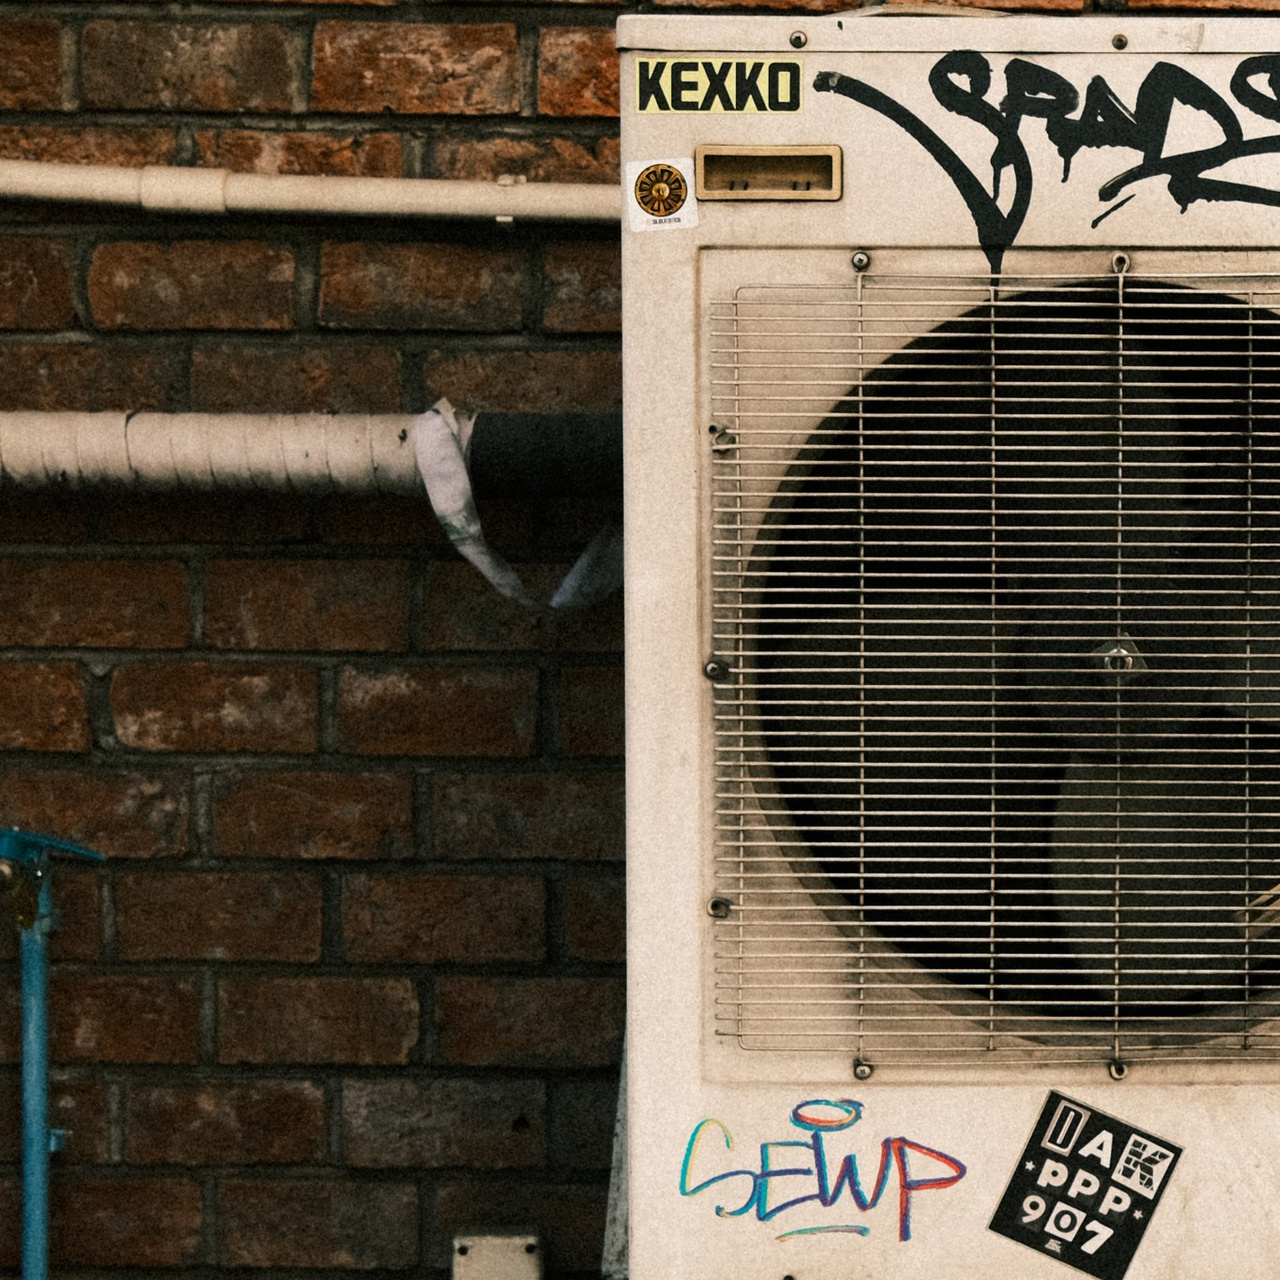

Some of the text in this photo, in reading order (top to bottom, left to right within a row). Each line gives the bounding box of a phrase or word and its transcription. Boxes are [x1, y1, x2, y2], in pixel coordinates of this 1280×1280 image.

[638, 61, 801, 111] KEXKO
[1043, 1102, 1172, 1196] DAK
[1021, 1195, 1114, 1255] 907
